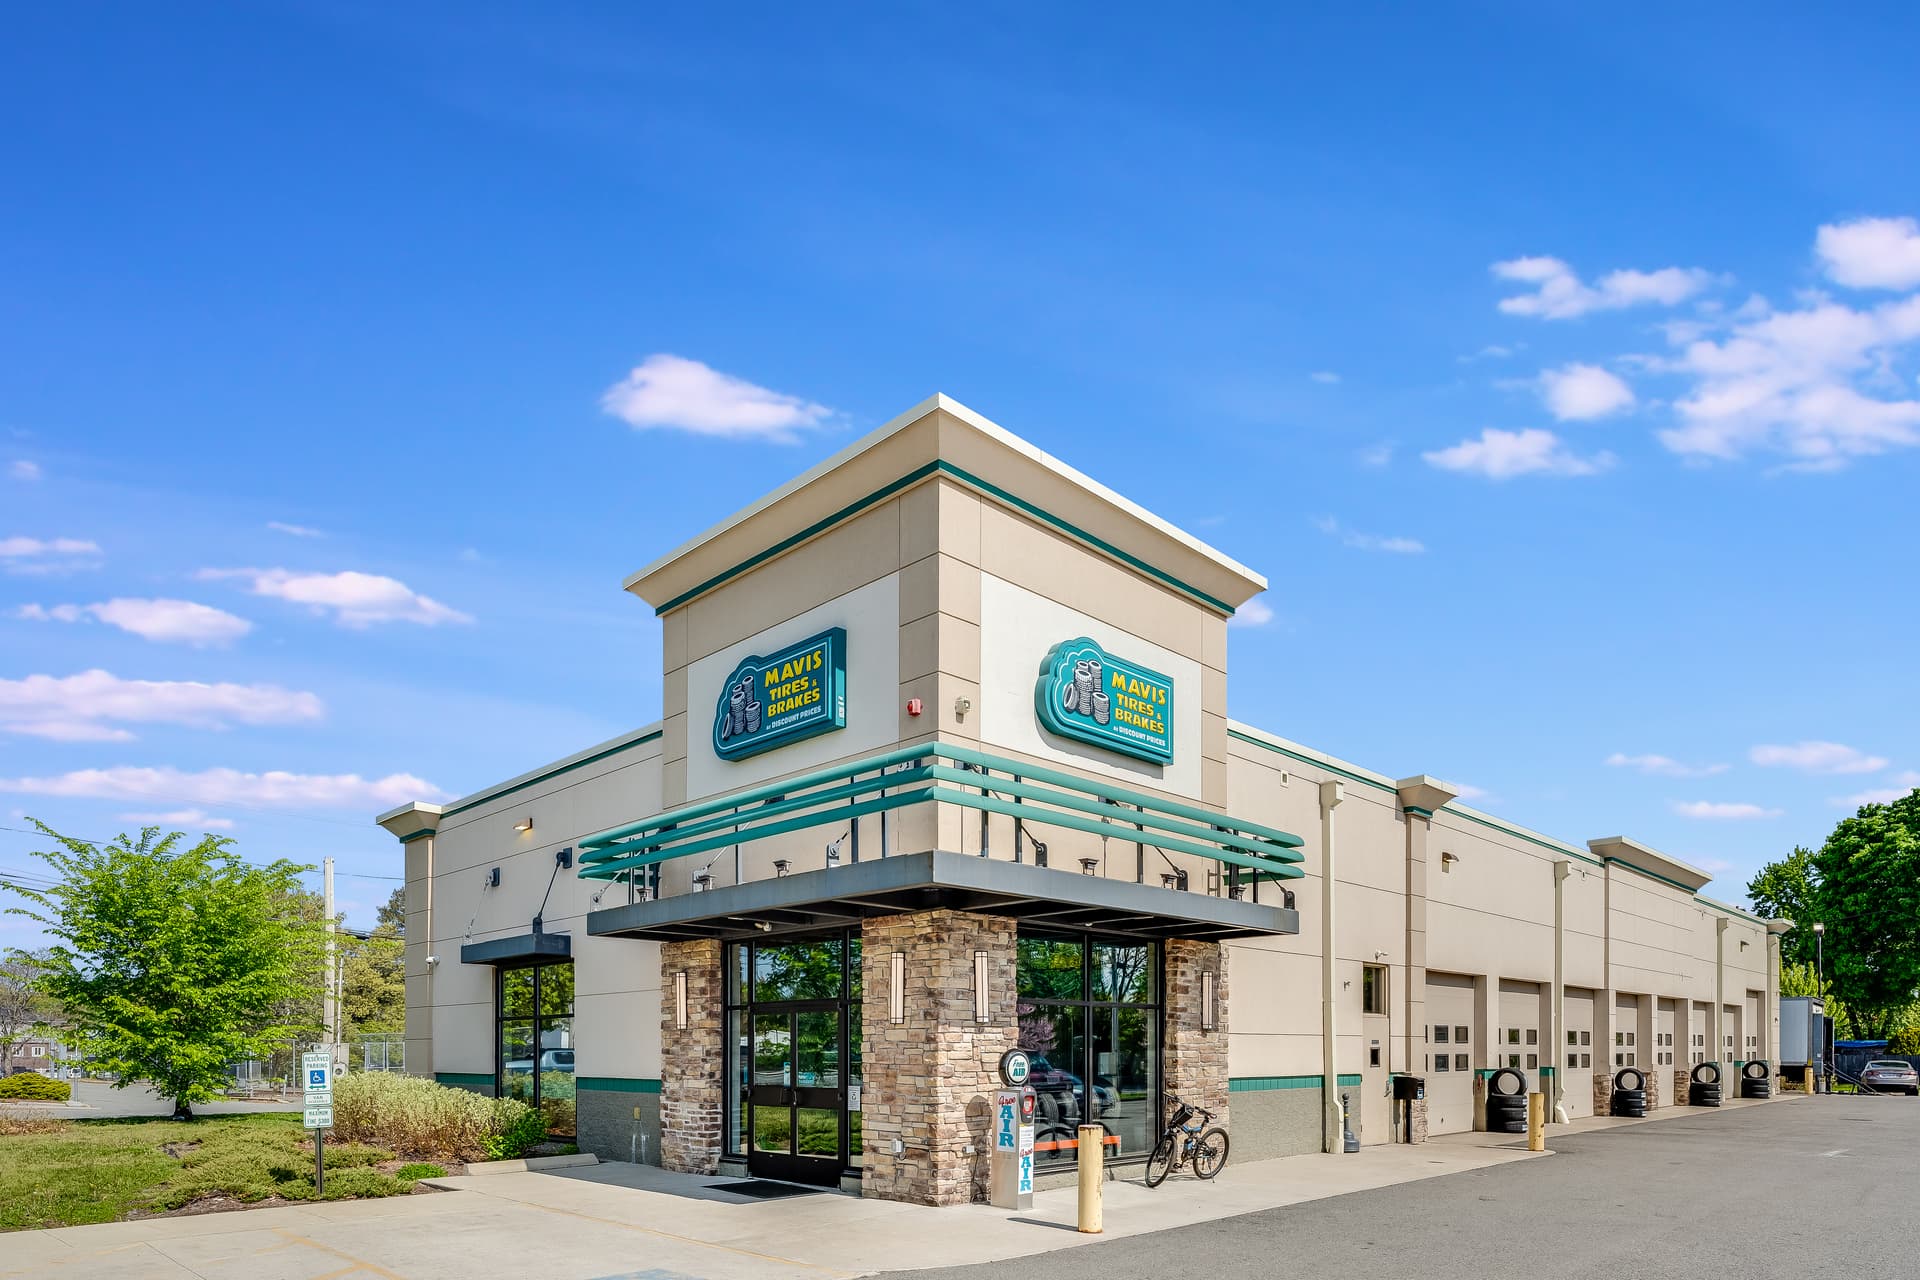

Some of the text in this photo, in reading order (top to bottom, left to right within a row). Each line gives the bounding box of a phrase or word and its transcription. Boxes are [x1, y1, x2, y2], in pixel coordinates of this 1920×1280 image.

[765, 650, 822, 687] MAVIS
[769, 676, 809, 701] TIRES
[1111, 671, 1166, 705] MAVIS
[767, 688, 820, 718] BRAKES
[771, 712, 800, 728] DISCOUNT
[800, 705, 821, 719] PRICES
[1116, 693, 1154, 716] TIRES
[1114, 708, 1165, 735] BRAKES
[1119, 726, 1146, 741] DISCOUNT
[1012, 1068, 1026, 1077] AIR
[999, 1106, 1014, 1147] AIR
[1020, 1156, 1032, 1192] AIR
